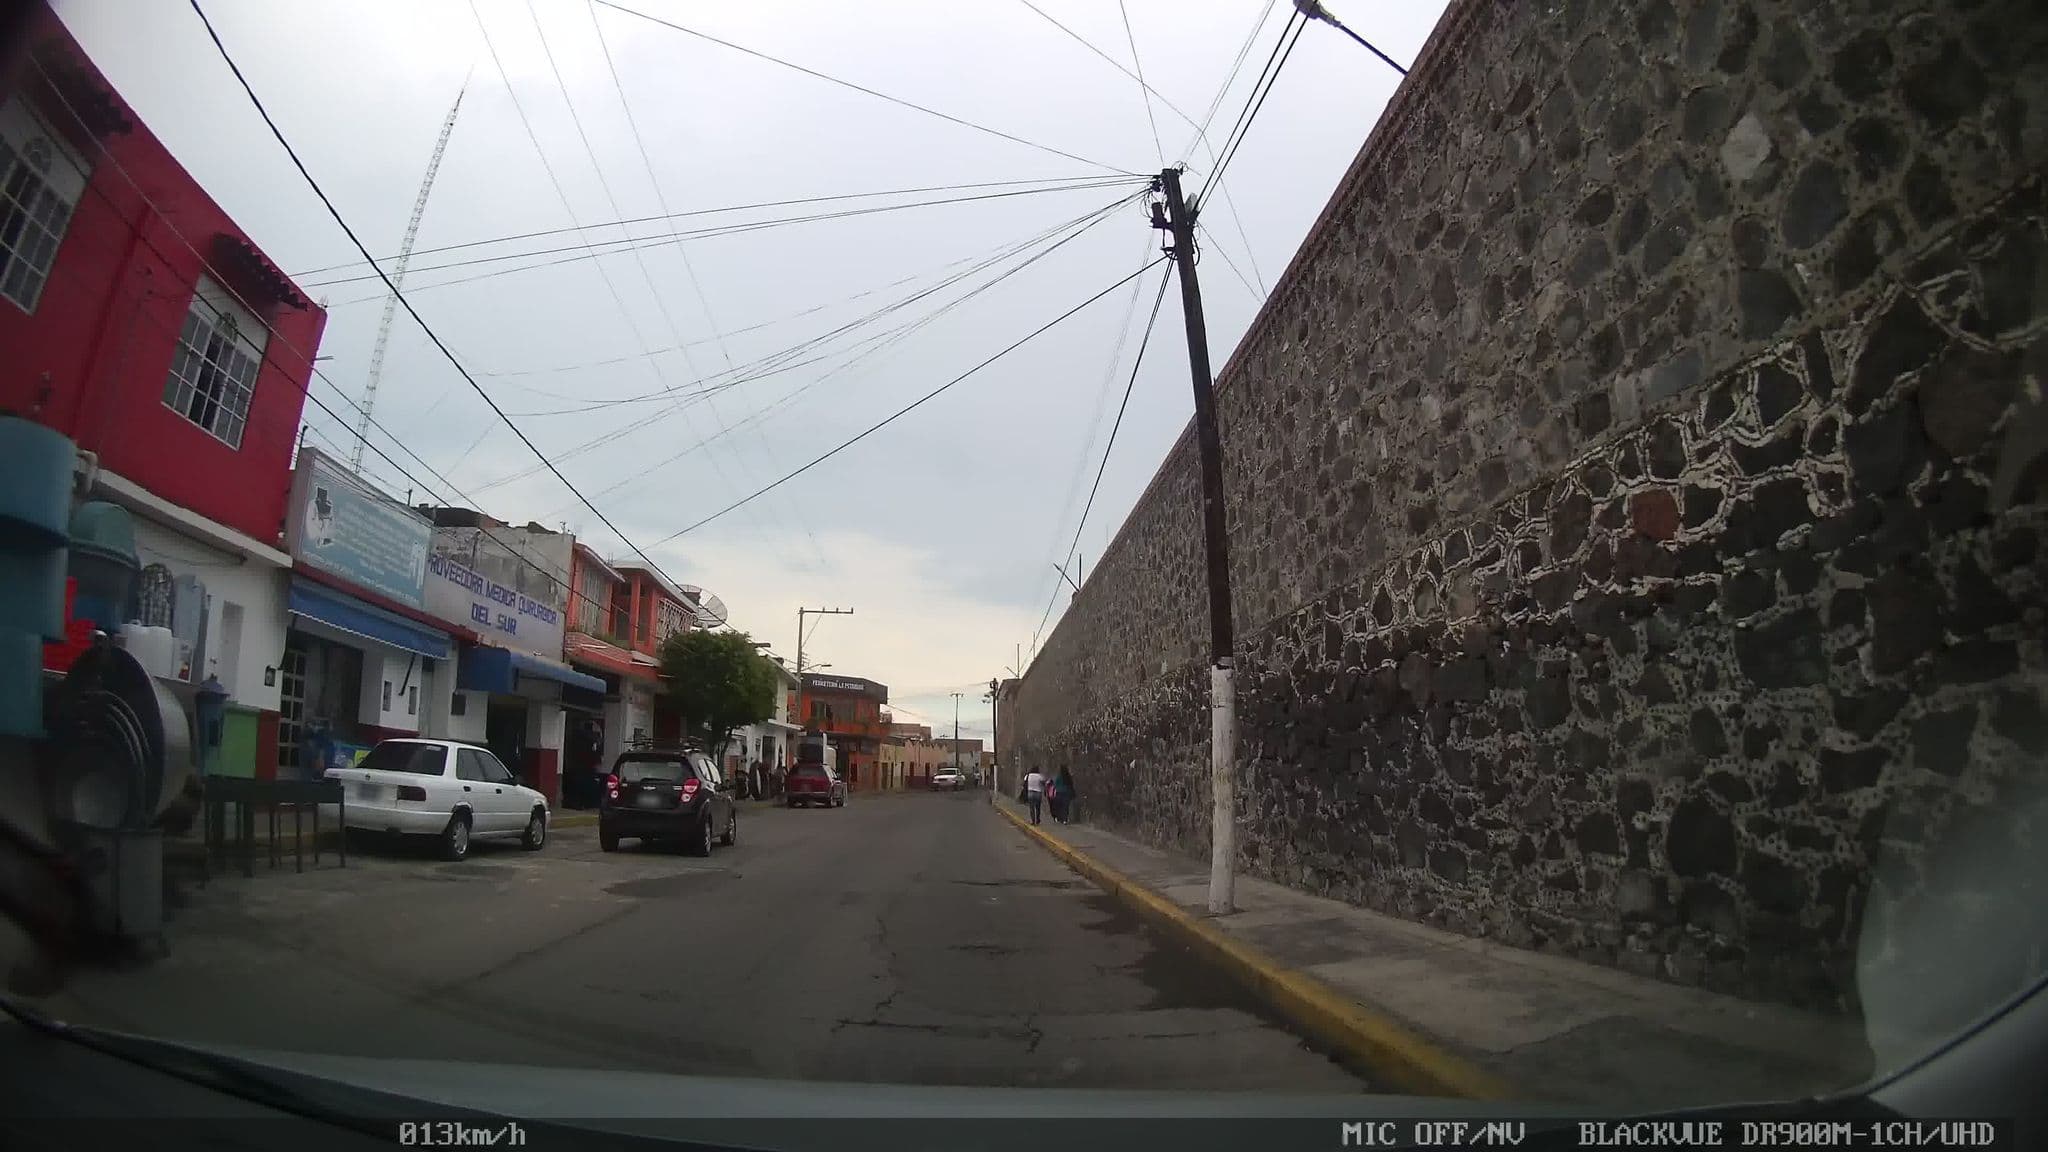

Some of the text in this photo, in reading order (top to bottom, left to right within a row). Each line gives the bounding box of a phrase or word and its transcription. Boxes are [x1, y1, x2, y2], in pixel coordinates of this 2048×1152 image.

[428, 553, 484, 595] ROVEEDORA
[486, 581, 517, 608] MEDICA
[471, 602, 517, 635] DEL SUR
